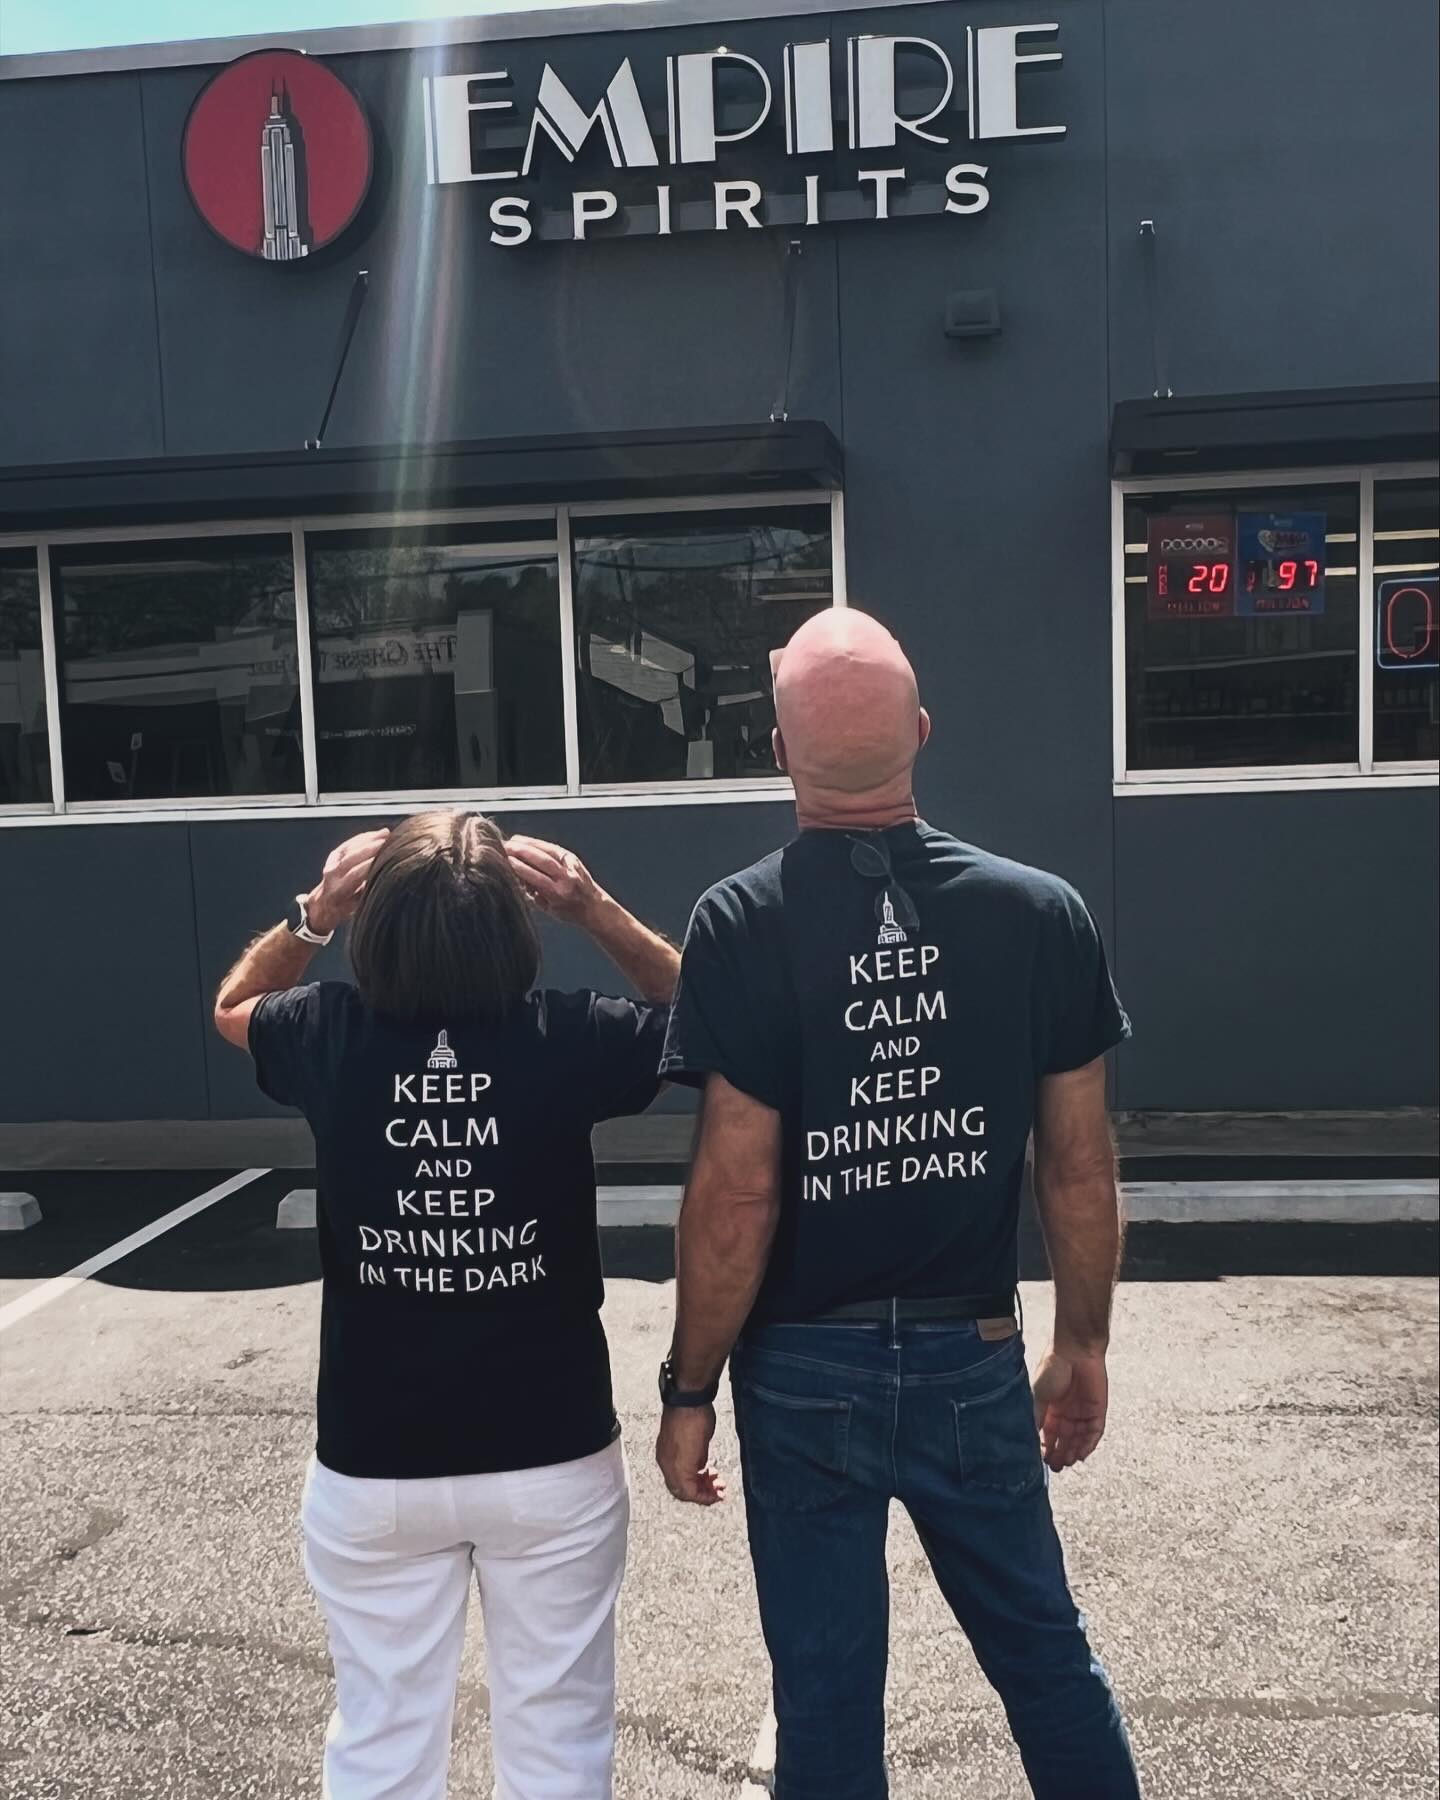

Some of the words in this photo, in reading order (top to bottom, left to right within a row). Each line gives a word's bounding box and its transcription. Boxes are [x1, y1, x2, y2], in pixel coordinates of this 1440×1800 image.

[422, 22, 1067, 185] EMPIRE
[489, 163, 990, 246] SPIRITS
[1188, 563, 1230, 593] 20
[1277, 559, 1319, 589] 97
[849, 945, 940, 985] KEEP
[844, 990, 947, 1031] CALM
[870, 1036, 921, 1062] AND
[394, 1073, 492, 1103] KEEP
[850, 1066, 941, 1106] KEEP
[385, 1117, 499, 1147] CALM
[806, 1106, 985, 1161] DRINKING
[415, 1159, 472, 1178] AND
[803, 1174, 832, 1201] IN
[840, 1160, 891, 1195] THE
[901, 1150, 988, 1183] DARK
[397, 1188, 495, 1217] KEEP
[358, 1218, 538, 1258] DRINKING
[359, 1261, 387, 1286] IN
[393, 1267, 455, 1293] THE
[465, 1254, 547, 1293] DARK
